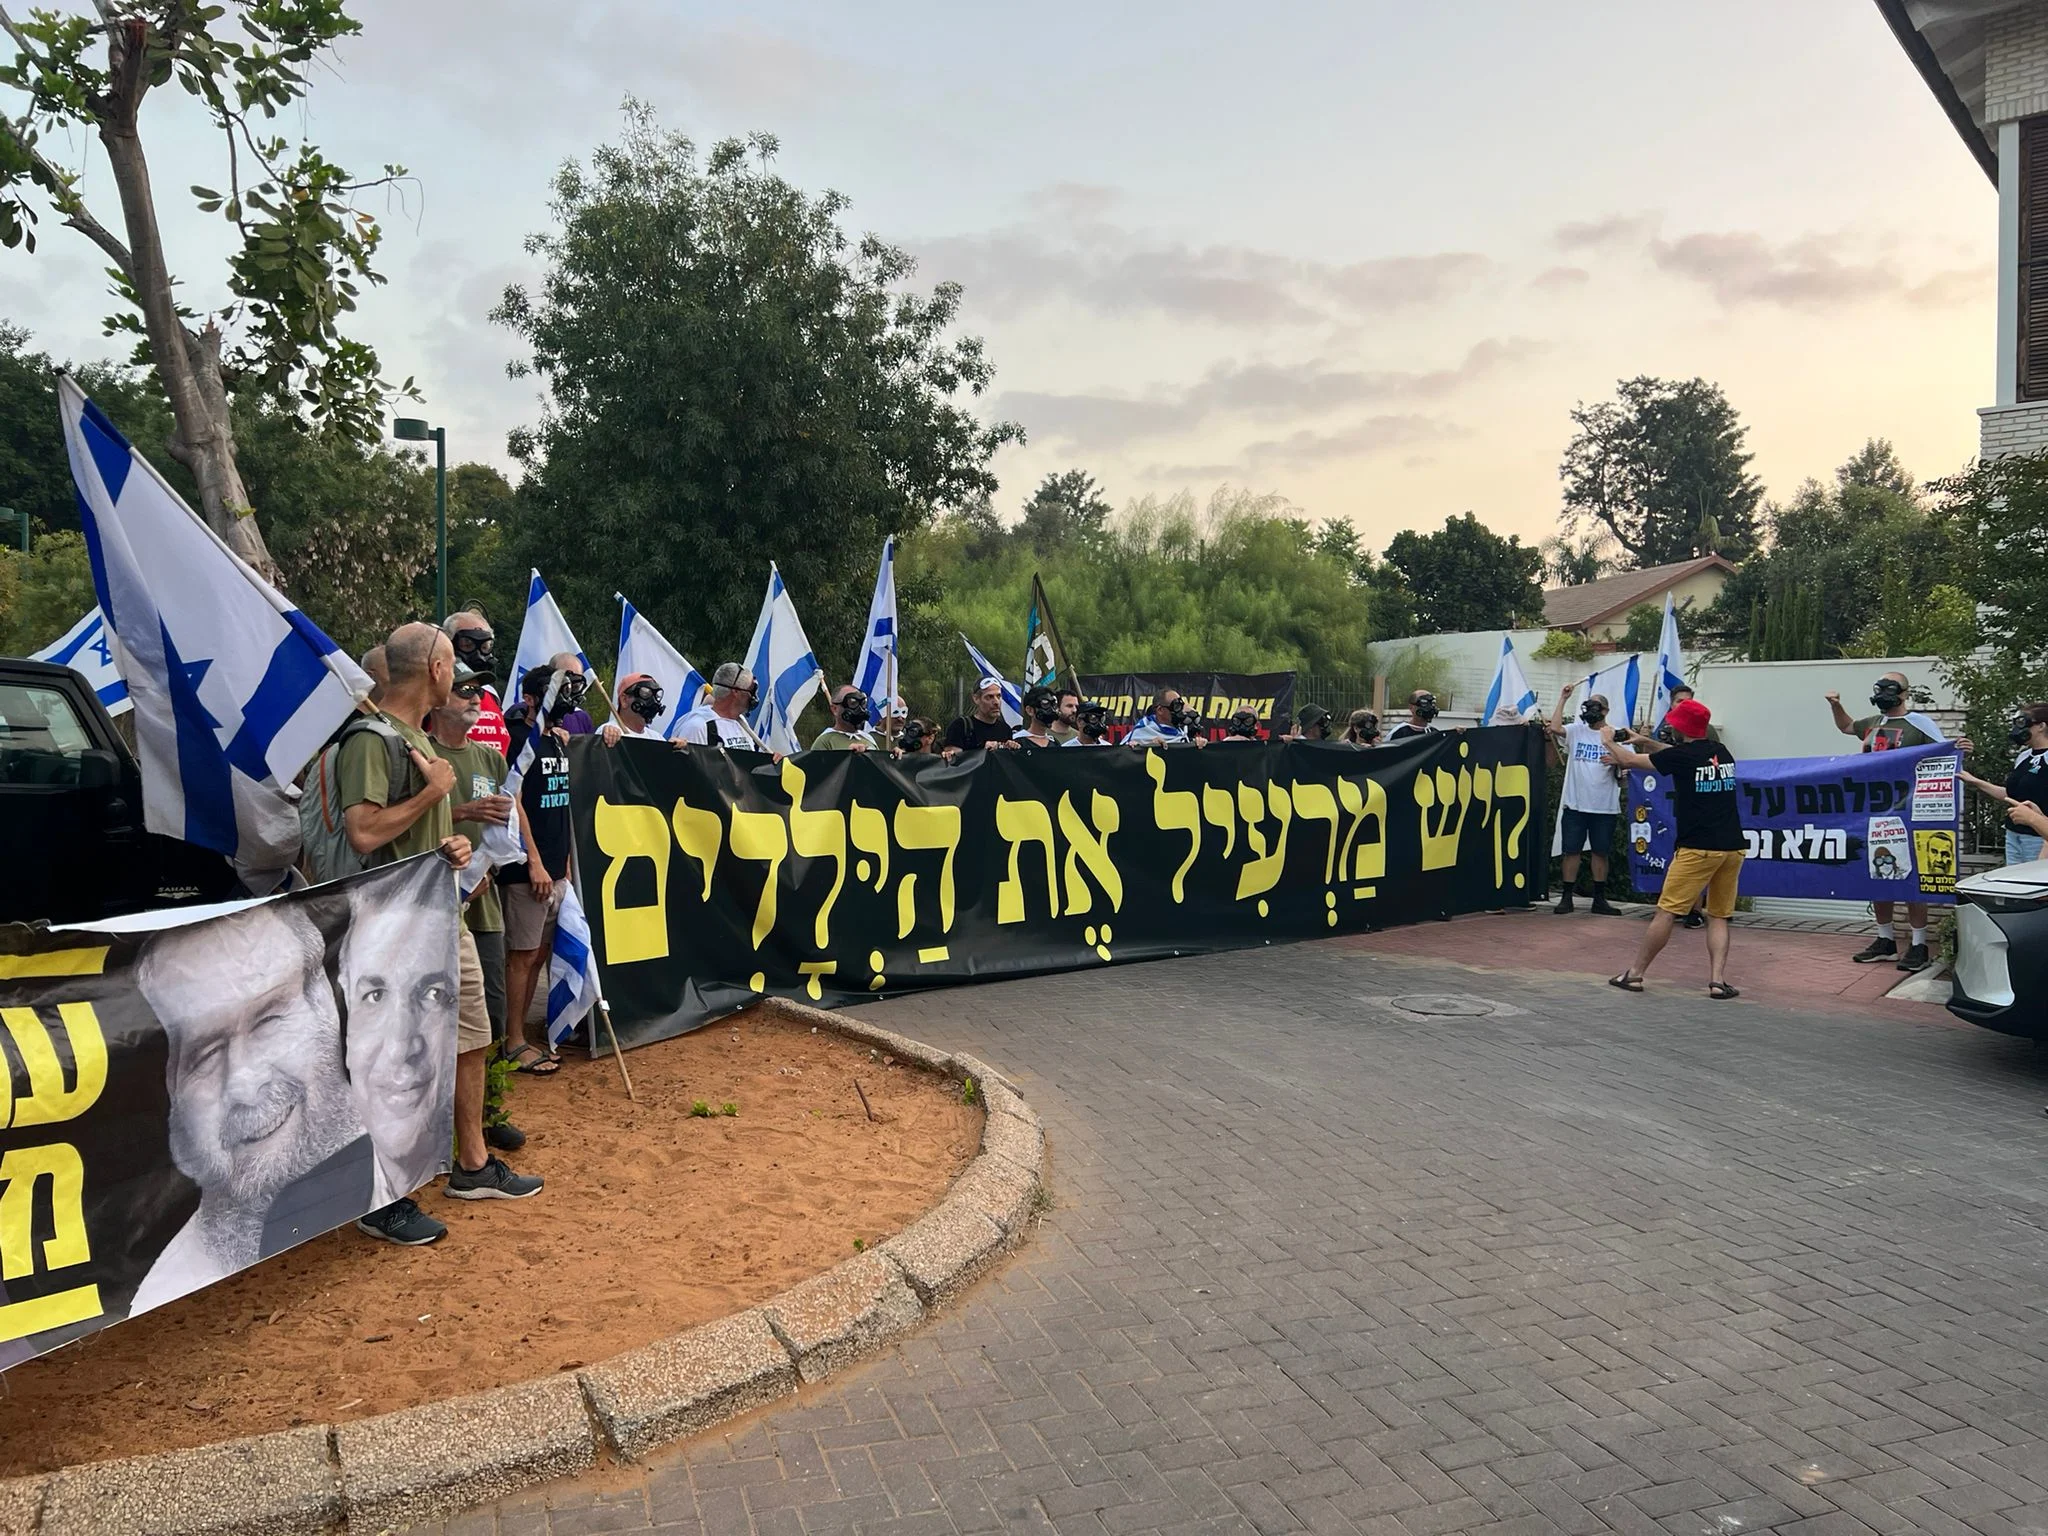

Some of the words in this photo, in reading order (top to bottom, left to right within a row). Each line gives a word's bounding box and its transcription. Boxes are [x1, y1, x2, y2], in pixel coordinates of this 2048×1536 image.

[1743, 782, 1786, 818] על
[1795, 777, 1910, 814] נפלתם
[1781, 824, 1847, 860] הלא
